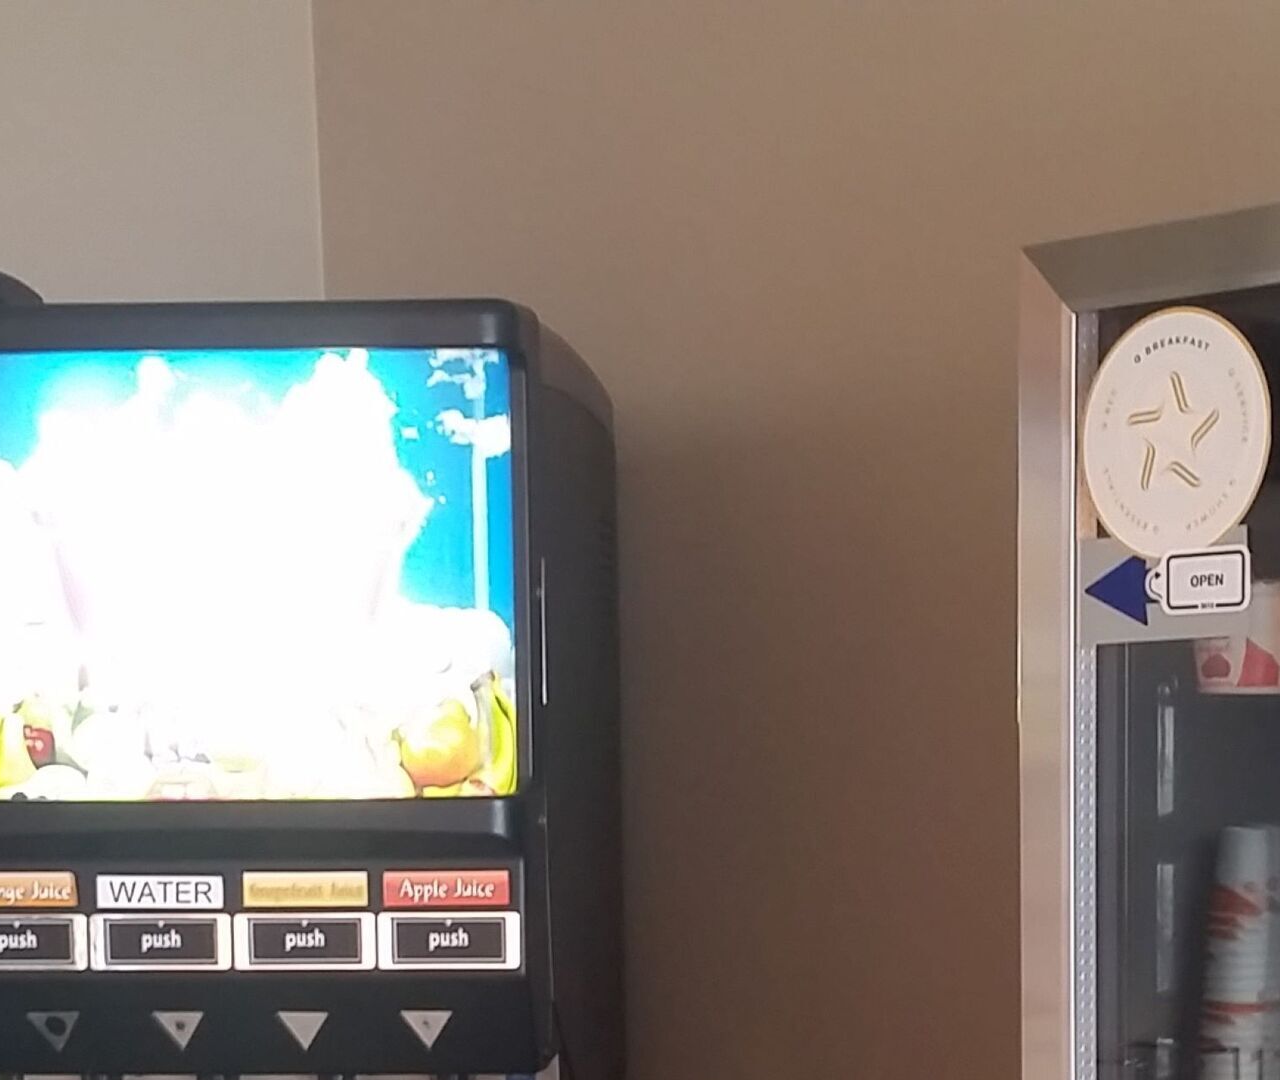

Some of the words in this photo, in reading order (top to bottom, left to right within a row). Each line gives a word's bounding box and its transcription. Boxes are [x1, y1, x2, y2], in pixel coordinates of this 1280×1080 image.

[1144, 335, 1211, 356] BREAKFAST
[1190, 573, 1224, 588] OPEN
[31, 881, 72, 900] Juice
[109, 880, 212, 904] WATER
[400, 878, 449, 904] Apple
[453, 877, 495, 898] Juice
[141, 929, 182, 953] push
[285, 928, 325, 952] push
[428, 927, 469, 952] push
